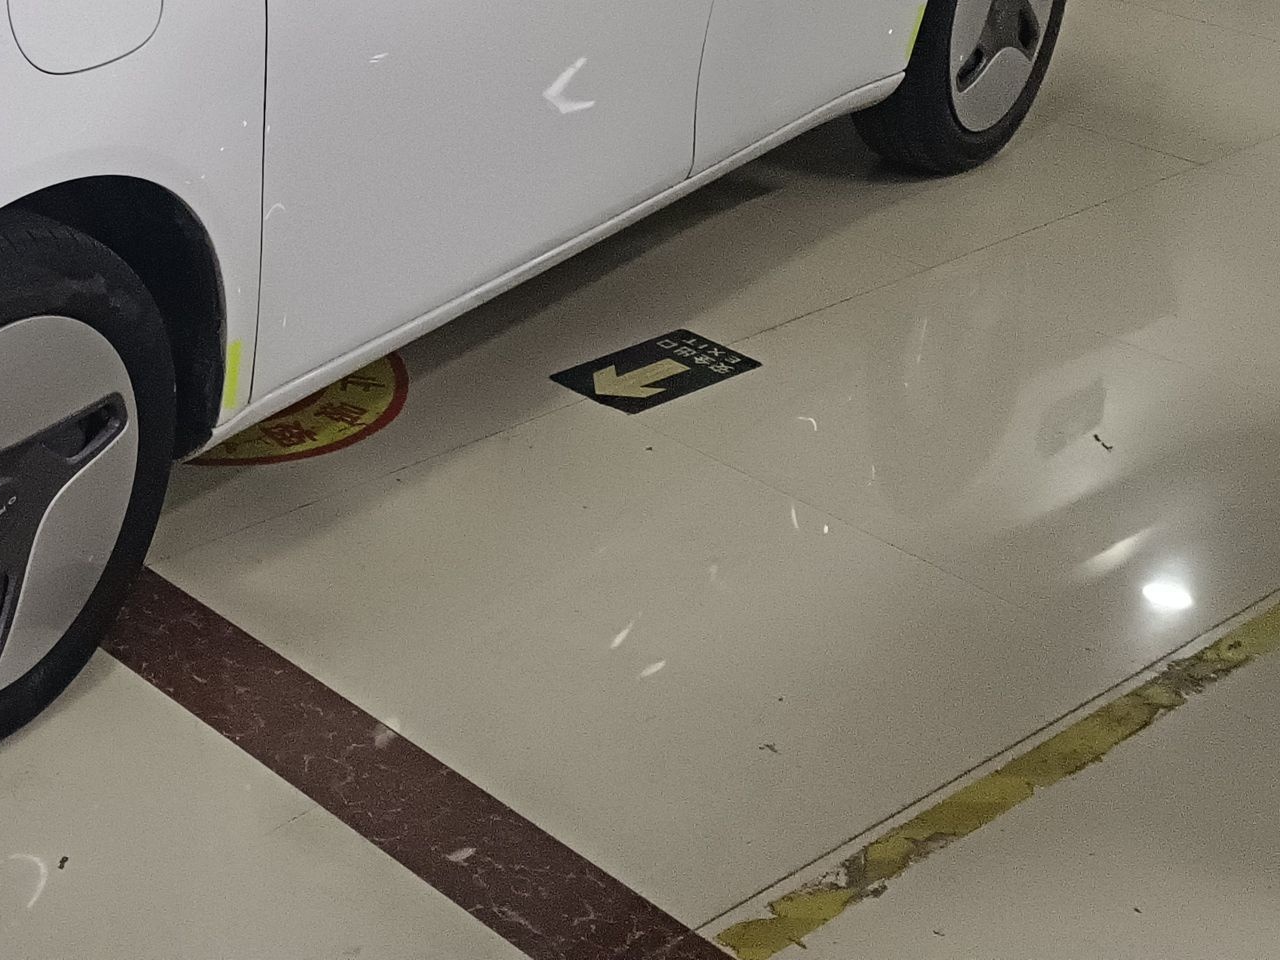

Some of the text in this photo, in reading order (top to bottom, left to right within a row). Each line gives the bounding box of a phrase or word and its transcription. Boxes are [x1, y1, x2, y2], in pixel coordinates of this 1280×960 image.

[656, 338, 736, 374] 安全出口
[681, 337, 743, 364] EXIT
